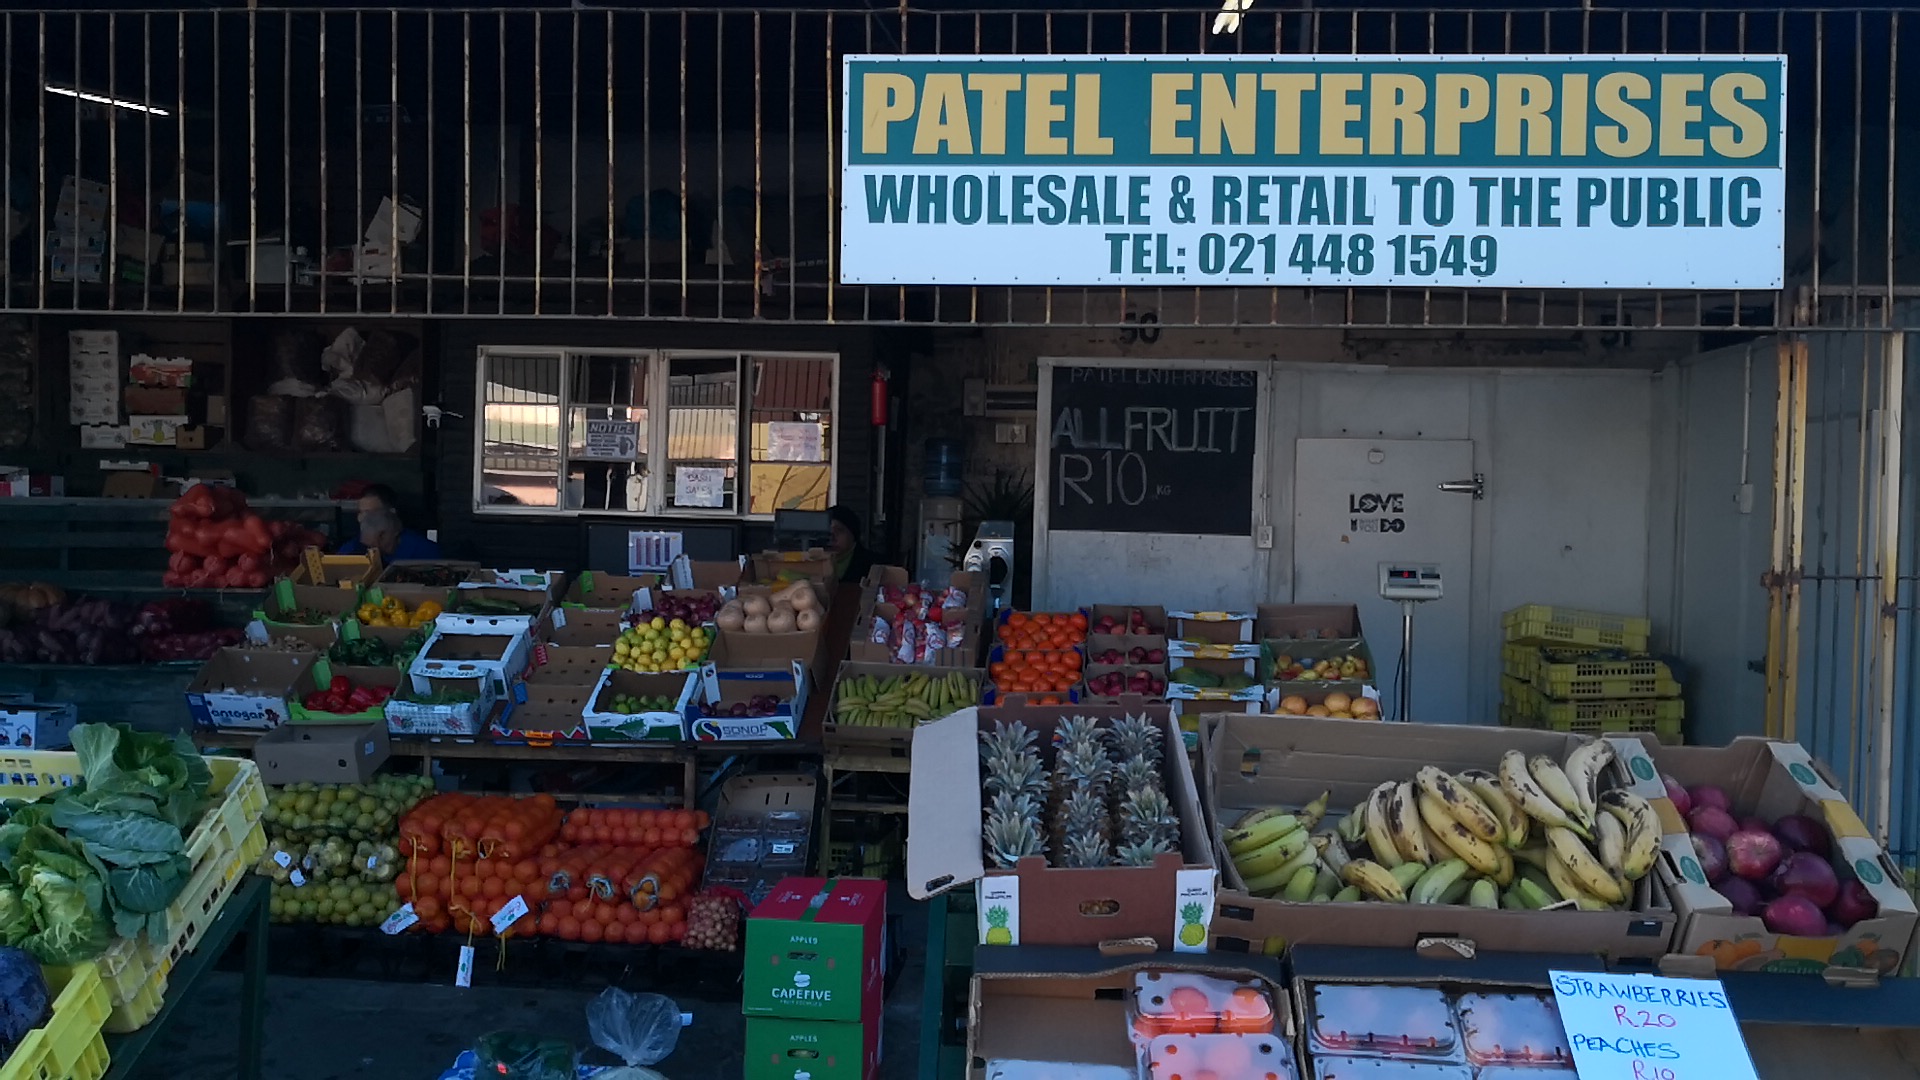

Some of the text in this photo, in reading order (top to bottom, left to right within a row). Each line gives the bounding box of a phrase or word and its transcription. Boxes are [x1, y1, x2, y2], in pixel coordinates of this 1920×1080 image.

[861, 71, 1768, 158] PATEL ENTERPRISES
[864, 174, 1762, 228] WHOLESALE & RETAIL TO THE PUBLIC
[1104, 232, 1498, 278] TEL: 021 448 1549
[589, 422, 633, 434] NOTICE
[1050, 406, 1254, 454] ALL FRUIT
[1058, 450, 1148, 506] R10
[1349, 493, 1404, 514] LOVE
[722, 724, 768, 735] SONOP
[789, 935, 818, 946] APPLES
[771, 987, 832, 1002] CAPEFIVE
[1555, 974, 1729, 1009] STRAWBERRIES
[1613, 1004, 1677, 1028] R20
[789, 1034, 818, 1043] APPLES
[1572, 1034, 1681, 1060] PEACHES
[1632, 1059, 1676, 1080] R10
